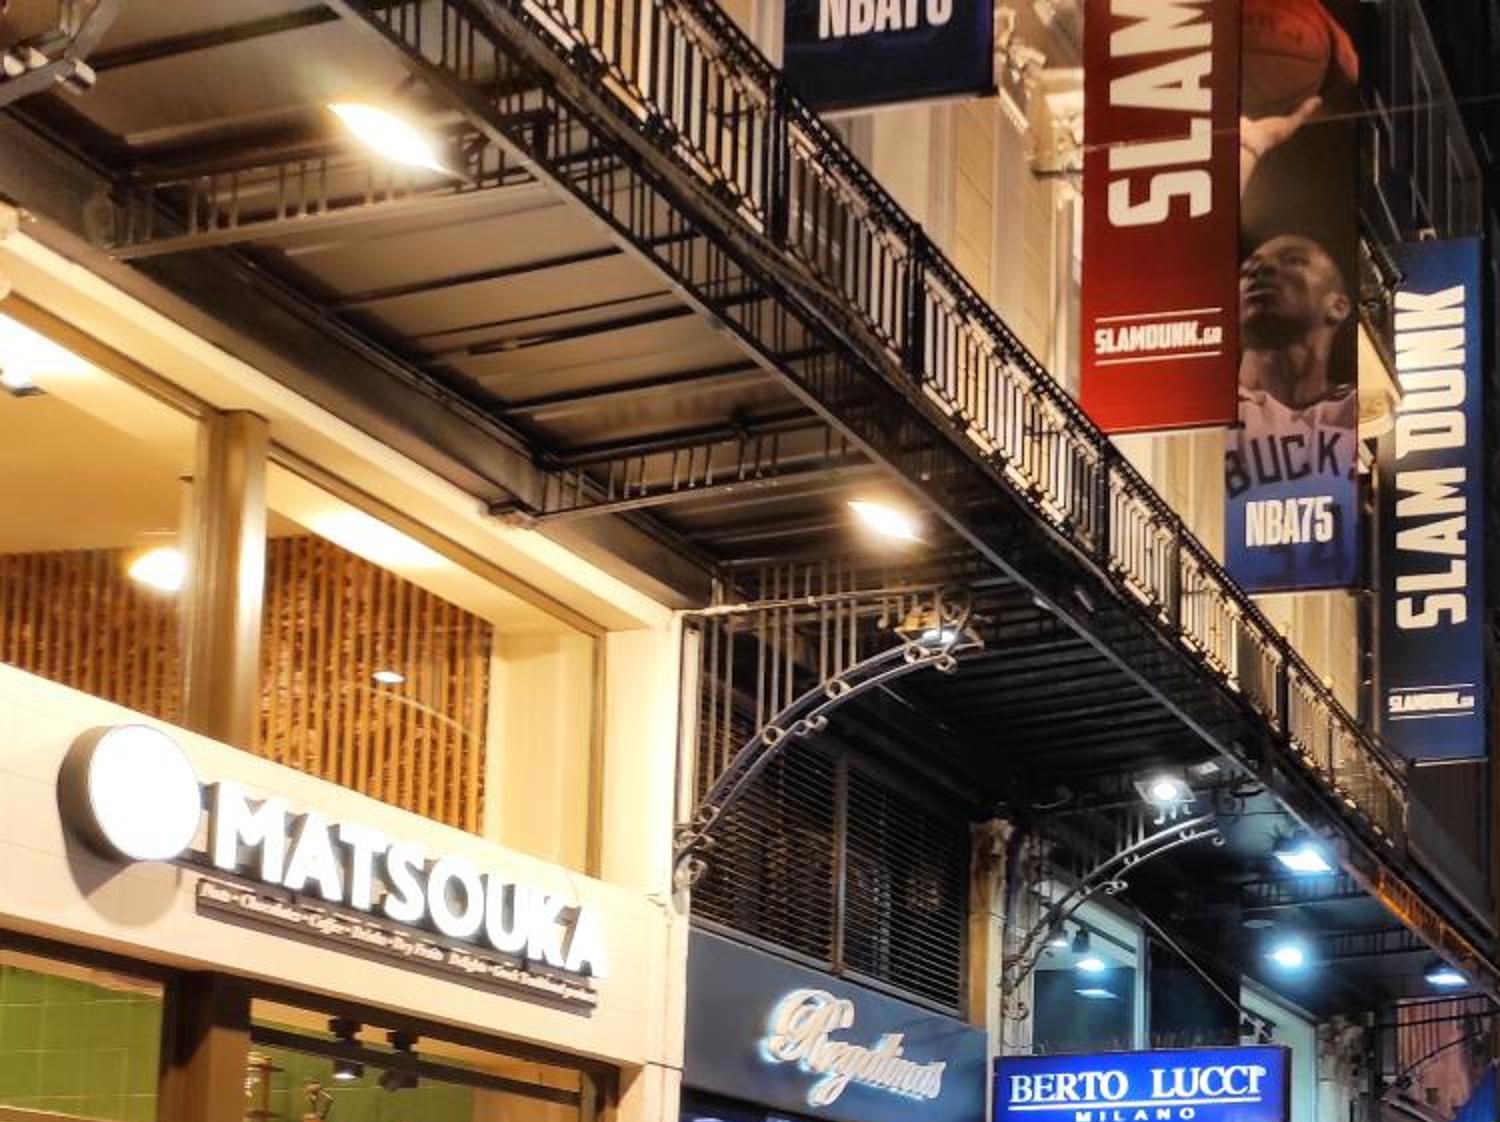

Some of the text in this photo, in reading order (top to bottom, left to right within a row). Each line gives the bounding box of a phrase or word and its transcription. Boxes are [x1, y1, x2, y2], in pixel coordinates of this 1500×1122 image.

[1225, 432, 1357, 498] BUCK
[1394, 285, 1467, 629] SLAM DUNK
[1246, 496, 1333, 548] NBA75
[215, 781, 607, 978] MATSOUKA
[1008, 1065, 1266, 1103] BERTO LUCCI
[1075, 1108, 1196, 1122] MILANO
